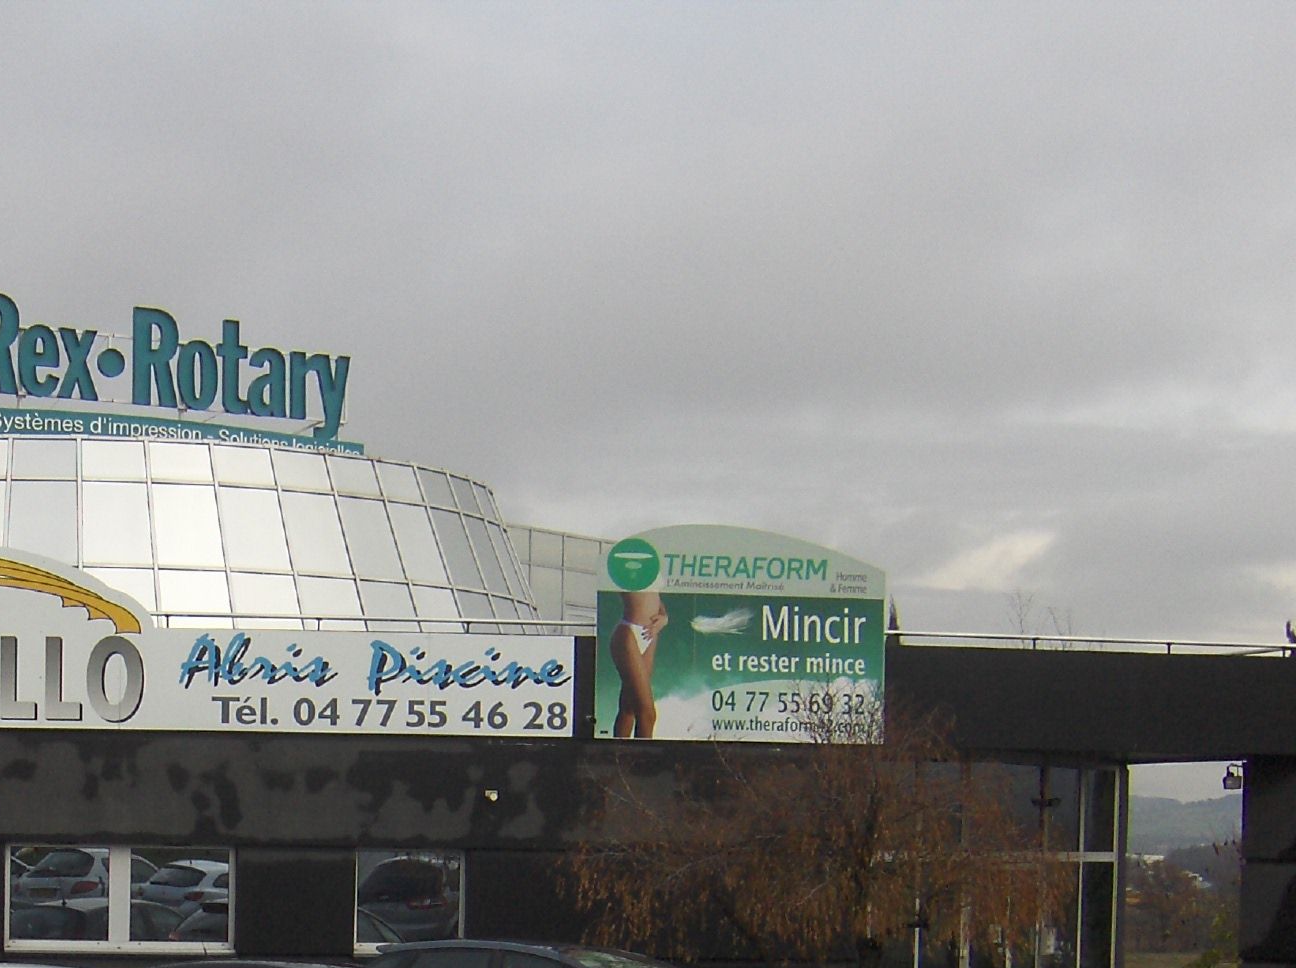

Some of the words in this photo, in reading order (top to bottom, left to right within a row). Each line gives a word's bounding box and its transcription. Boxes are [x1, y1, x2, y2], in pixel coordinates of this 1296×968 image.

[90, 416, 202, 440] d'impression
[664, 554, 828, 581] THERAFORM
[836, 572, 868, 582] Homme
[838, 584, 868, 594] Femme
[762, 605, 866, 644] Mincir
[179, 632, 338, 689] Abris
[367, 639, 572, 695] Piscine
[712, 653, 732, 672] et
[739, 654, 799, 673] rester
[806, 653, 866, 675] mince
[211, 696, 280, 726] Tél.
[293, 697, 340, 726] 04
[351, 698, 398, 728] 77
[406, 699, 448, 729] 55
[461, 701, 509, 730] 46
[522, 702, 568, 730] 28
[712, 690, 736, 712] 04
[746, 691, 769, 712] 77
[778, 692, 801, 713] 55
[809, 692, 833, 714] 69
[842, 693, 865, 715] 32
